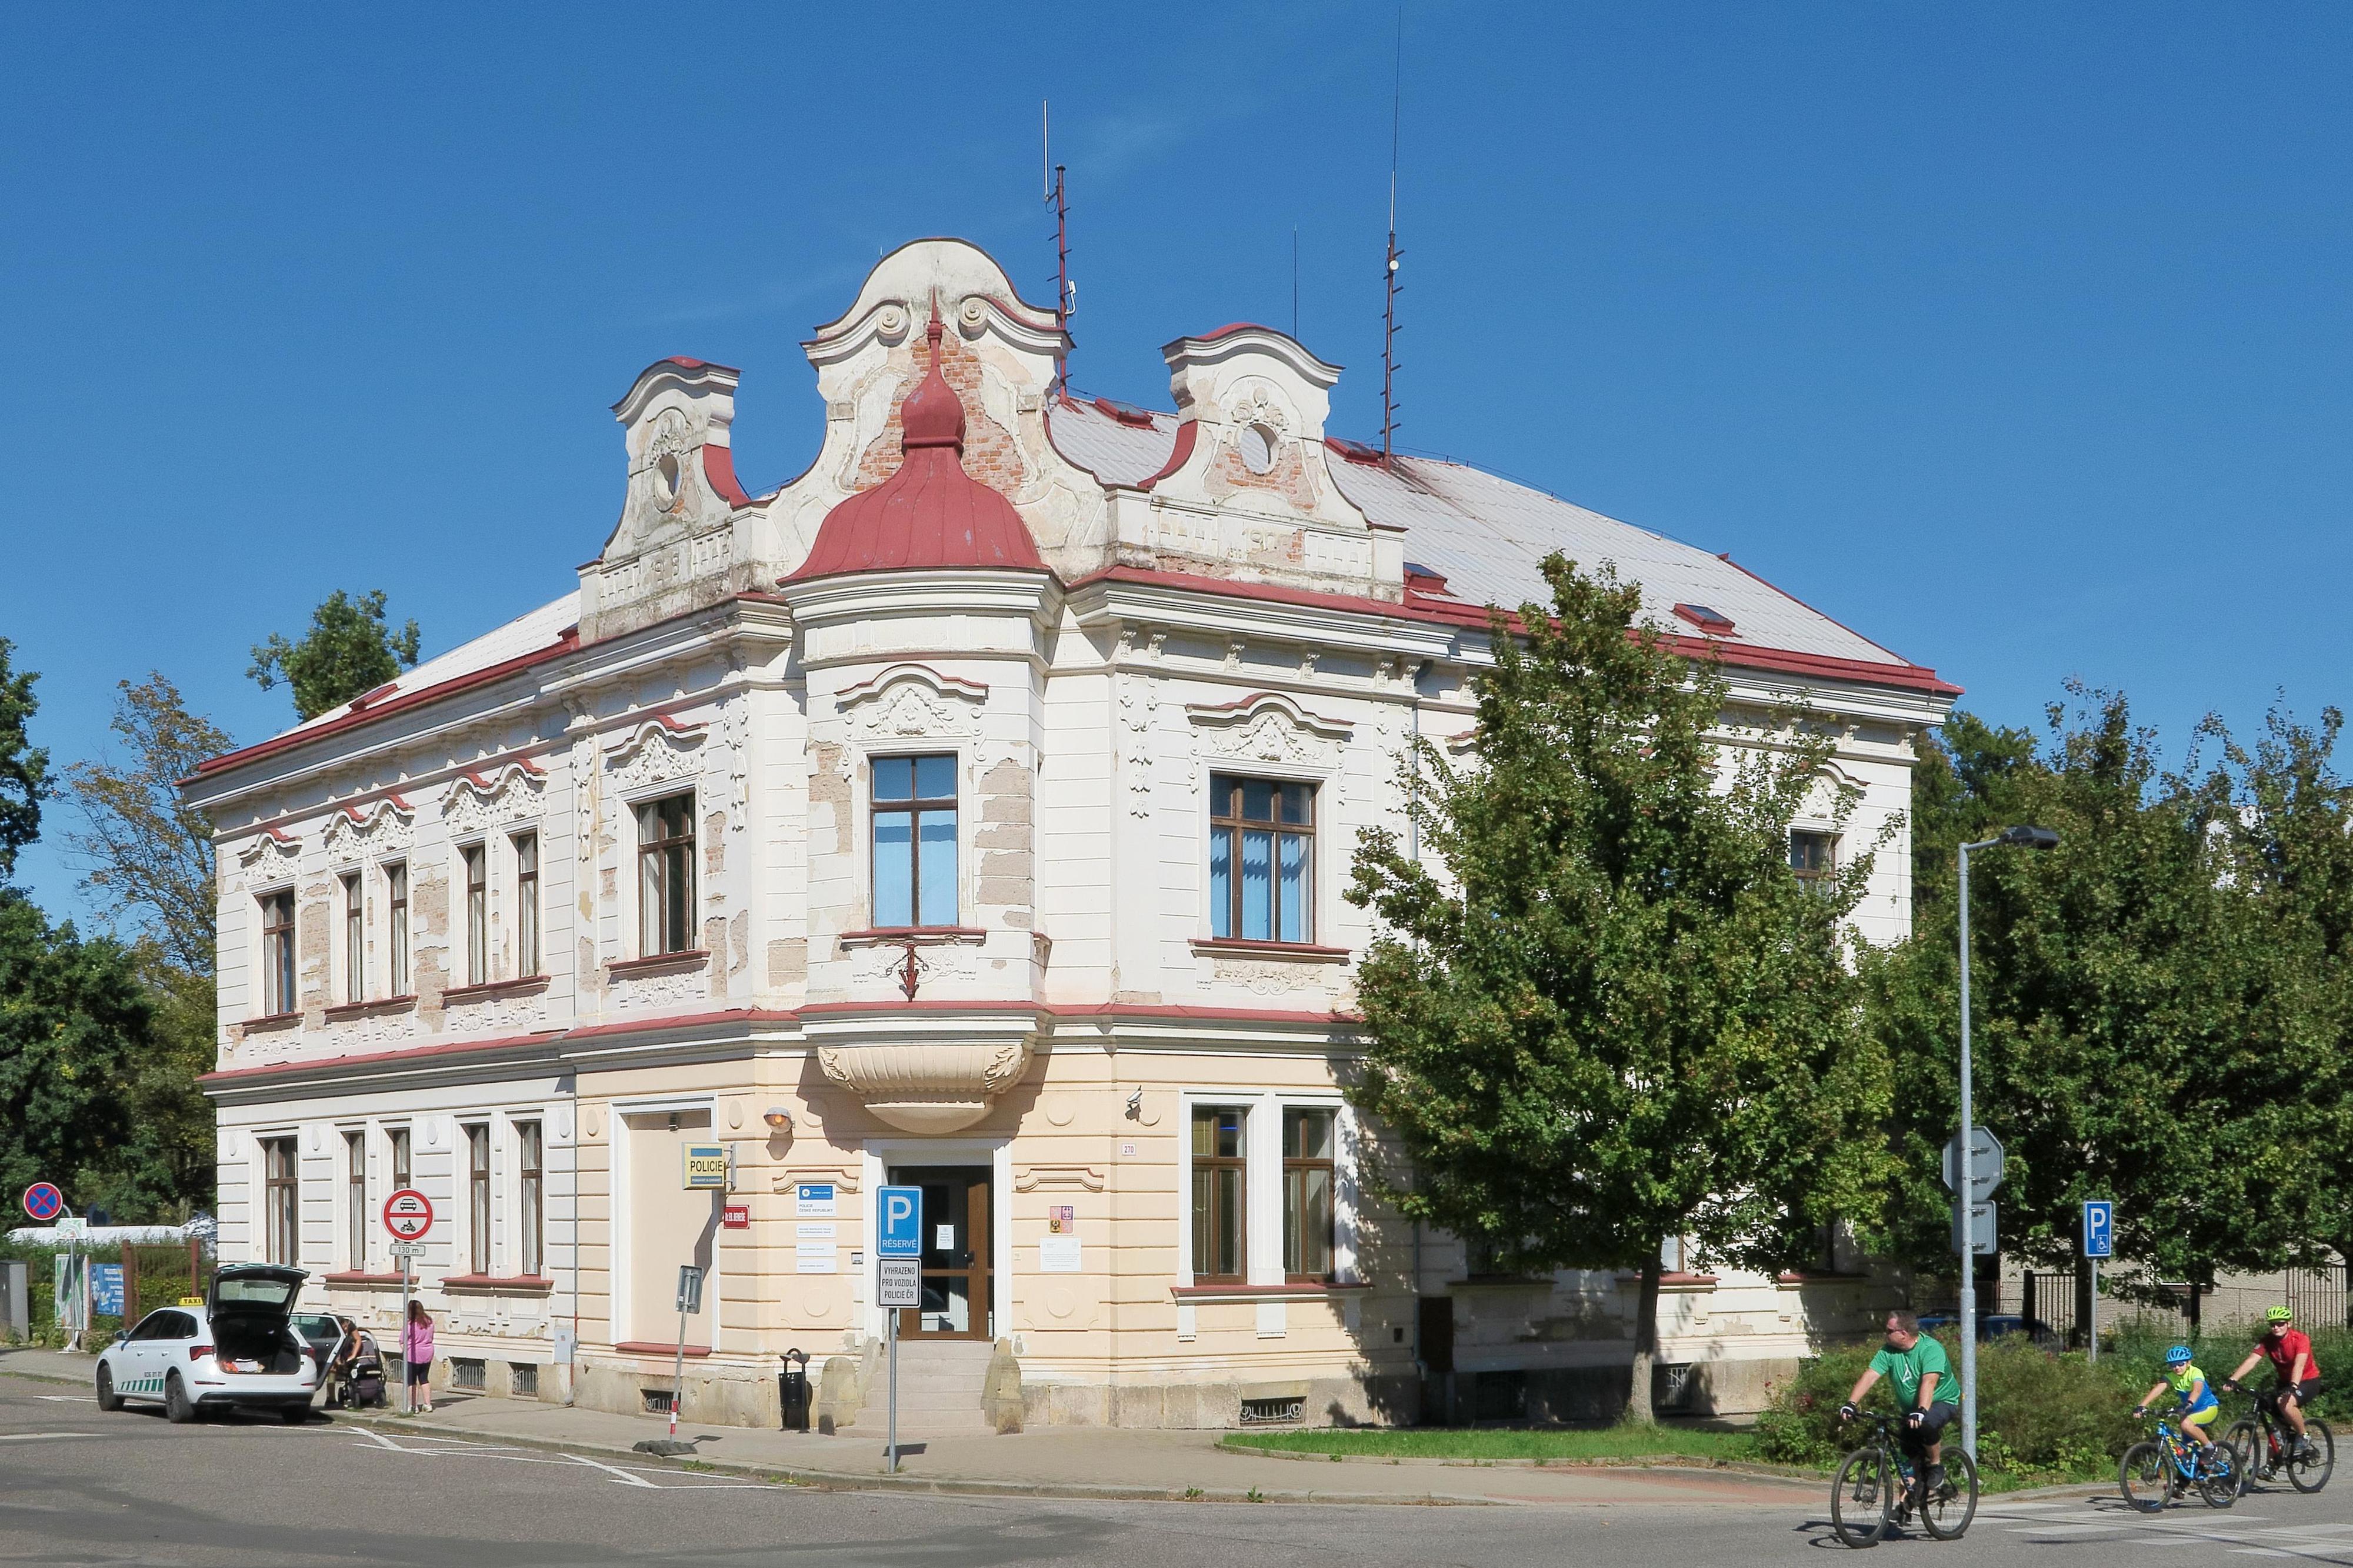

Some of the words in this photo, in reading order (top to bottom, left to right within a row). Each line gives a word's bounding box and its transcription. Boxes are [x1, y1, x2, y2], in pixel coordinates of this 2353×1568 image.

[691, 1161, 723, 1172] POLICIE
[888, 1196, 912, 1234] P
[2090, 1208, 2106, 1239] P
[882, 1238, 917, 1248] RÉSERVÉ
[894, 1279, 916, 1287] VOZIDLA
[884, 1290, 905, 1299] POLICIE
[906, 1289, 914, 1299] ČR
